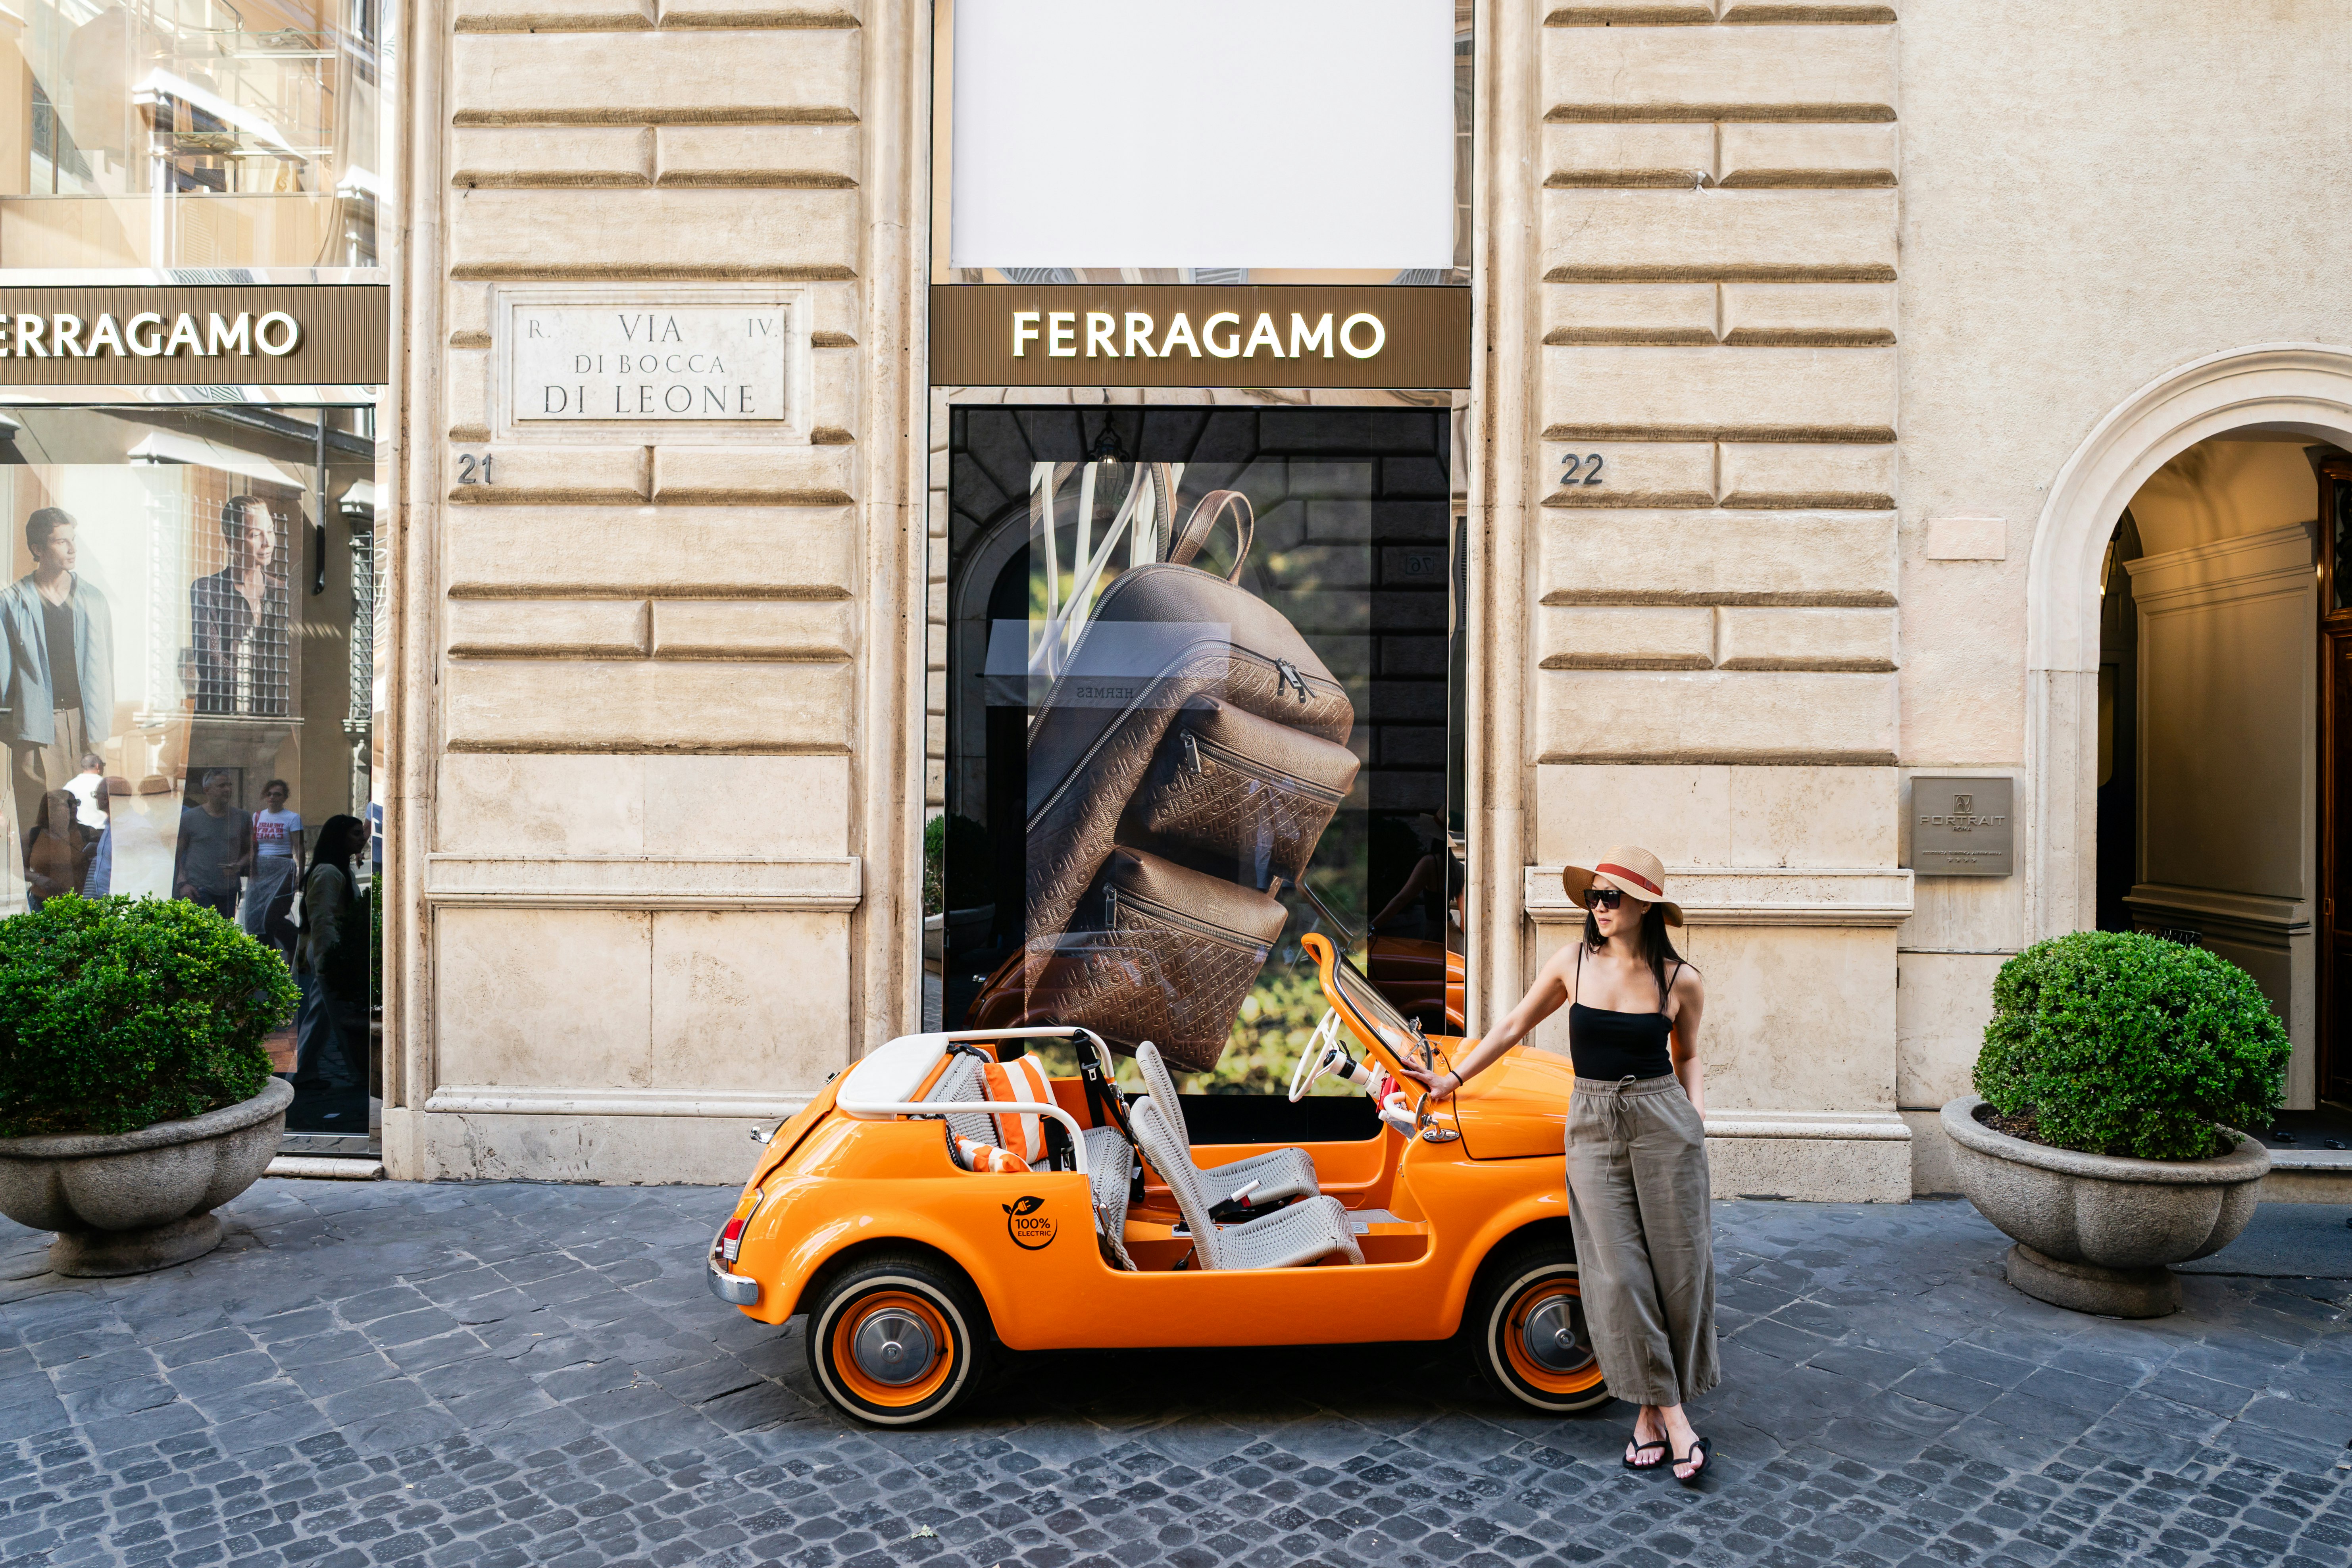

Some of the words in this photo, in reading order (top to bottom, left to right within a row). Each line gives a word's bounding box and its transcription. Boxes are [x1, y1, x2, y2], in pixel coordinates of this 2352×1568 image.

[0, 311, 299, 357] RRAGAMO
[529, 319, 551, 338] R.
[618, 315, 683, 342] VIA
[748, 319, 778, 337] IV.
[1013, 312, 1385, 358] FERRAGAMO
[575, 354, 604, 373] DI
[619, 354, 725, 373] BOCCA
[544, 385, 585, 414] DI
[615, 385, 755, 414] LEONE
[458, 453, 491, 485] 21
[1560, 453, 1603, 484] 22
[1919, 815, 2005, 826] PORTRAIT
[1015, 1218, 1051, 1229] 100%
